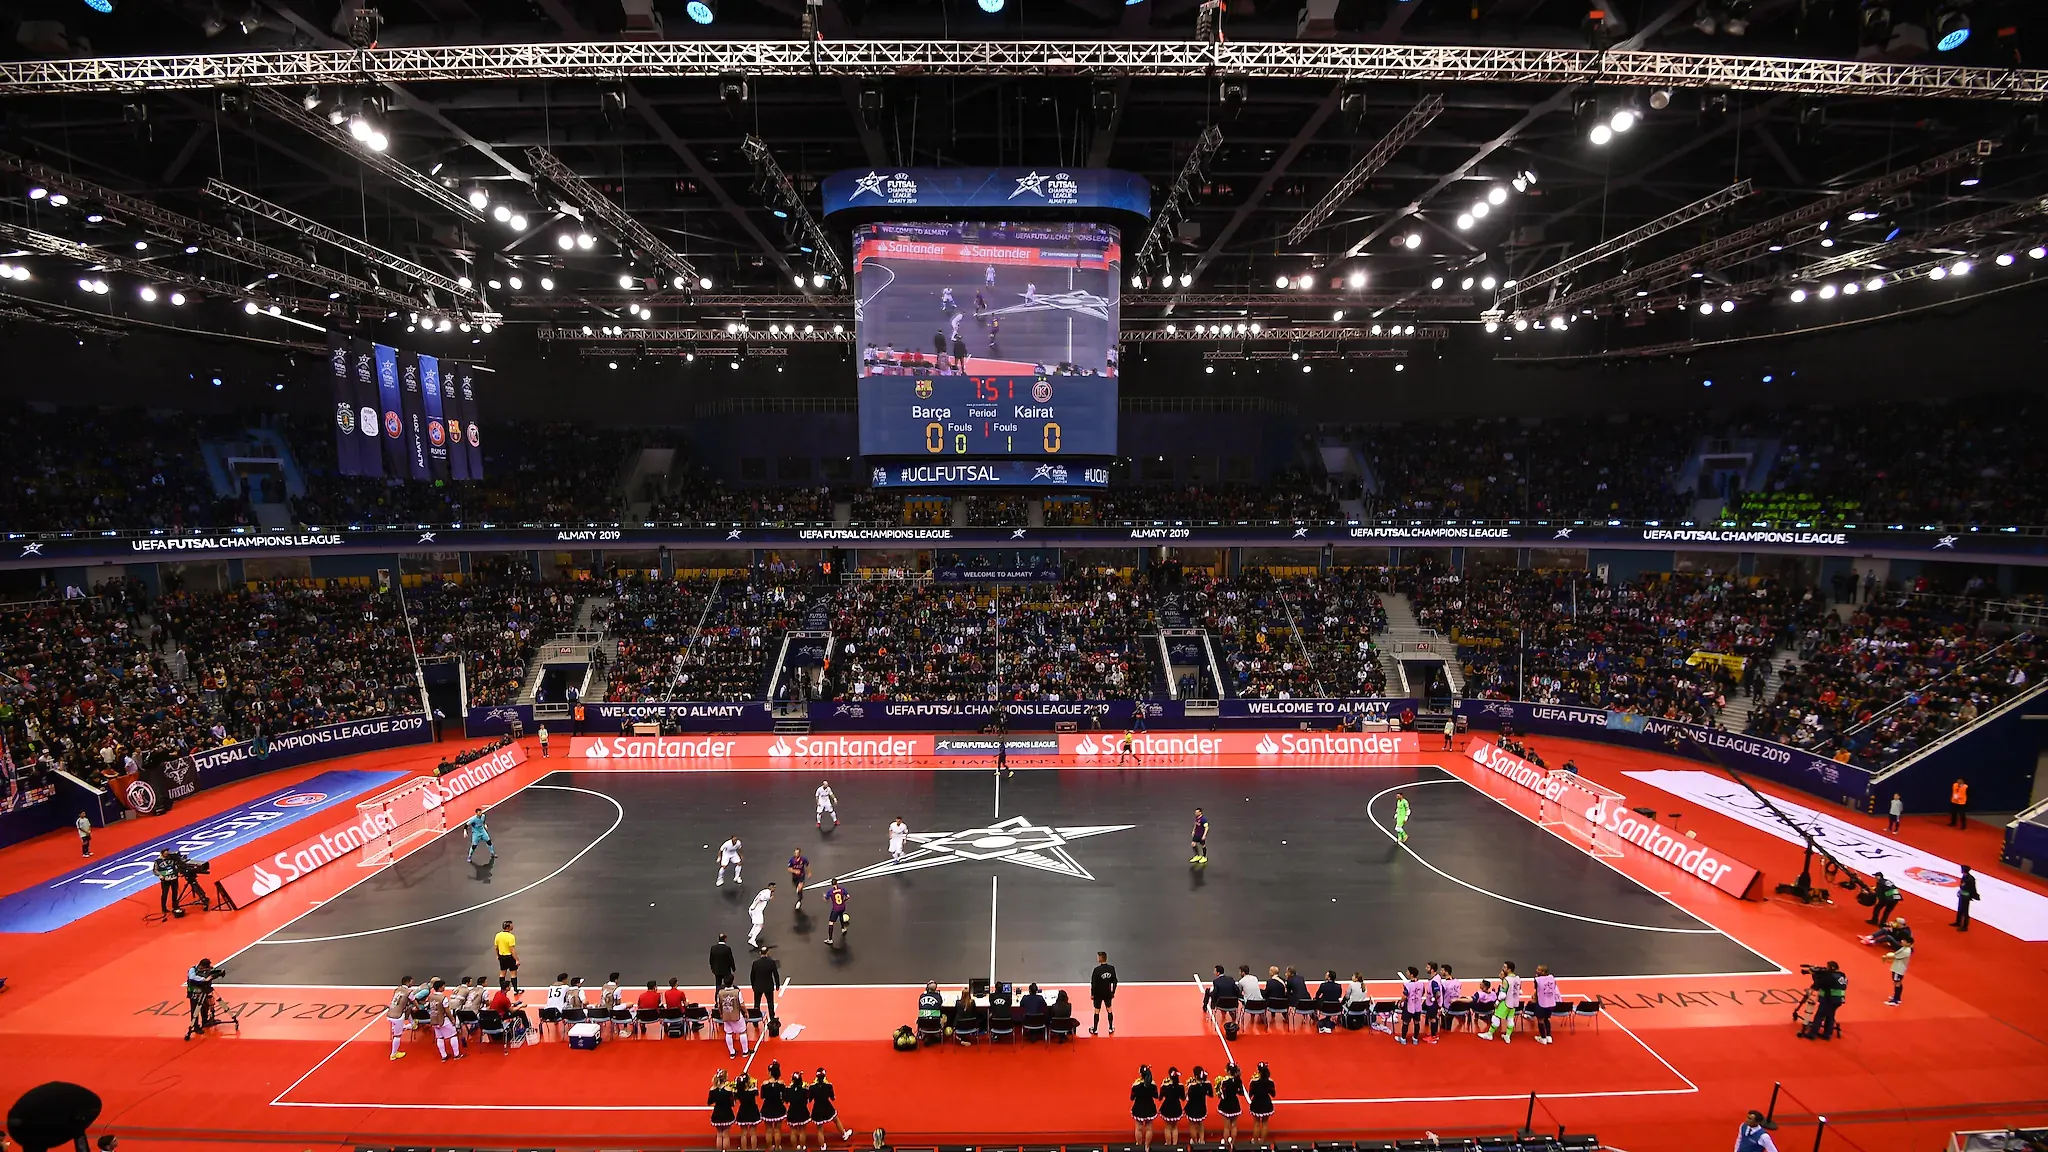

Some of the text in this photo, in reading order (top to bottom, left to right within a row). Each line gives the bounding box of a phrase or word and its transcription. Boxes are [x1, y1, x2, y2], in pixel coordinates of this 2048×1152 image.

[882, 226, 913, 234] WELCOME
[888, 241, 945, 255] Santander
[972, 246, 1031, 259] Santander
[912, 405, 951, 421] Barça
[969, 408, 997, 418] Period
[1014, 405, 1054, 419] Kairat
[948, 422, 972, 432] Fouls
[984, 421, 989, 438] 1
[993, 422, 1018, 432] Fouls
[412, 413, 424, 467] ALMATY 2019
[926, 422, 943, 453] 0
[955, 433, 967, 454] 0
[1007, 435, 1012, 452] 1
[1043, 422, 1061, 453] 0
[901, 466, 1000, 482] #UCLFUTSAL
[558, 531, 620, 540] ALMATY 2019
[800, 530, 951, 539] UEFA FUTSAL CHAMPIONS LEAGUE
[1131, 529, 1190, 538] ALMATY 2019
[1350, 528, 1508, 538] UEFA FUTSAL CHAMPIONS LEAGUE
[1643, 530, 1846, 544] UEFA FUTSAL CHAMPIONS LEAGUE
[132, 535, 341, 550] UEFA FUTSAL CHAMPIONS LEAGUE
[600, 706, 744, 717] WELCOME TO ALMATY
[886, 705, 915, 716] UEFA
[1036, 704, 1081, 716] LEAGUE
[1248, 702, 1313, 714] WELCOME
[1317, 702, 1334, 713] TO
[1532, 707, 1567, 721] UEFA
[1708, 732, 1761, 757] LEAGUE
[1762, 746, 1792, 764] 2019
[195, 717, 423, 773] FUTSAL CAMPIONS LEAGUE 2019
[612, 737, 736, 758] Santander
[794, 736, 917, 757] Santander
[951, 741, 969, 749] UEFA
[969, 741, 991, 749] FUTSAL
[1281, 733, 1402, 754] Santander
[438, 749, 517, 802] Santander
[1486, 747, 1568, 802] Santander
[274, 807, 397, 881] Santander
[1605, 806, 1732, 885] Santander
[835, 893, 843, 905] 8
[548, 987, 562, 999] 15
[1595, 990, 1744, 1009] ALMATY
[293, 1003, 391, 1020] 2019
